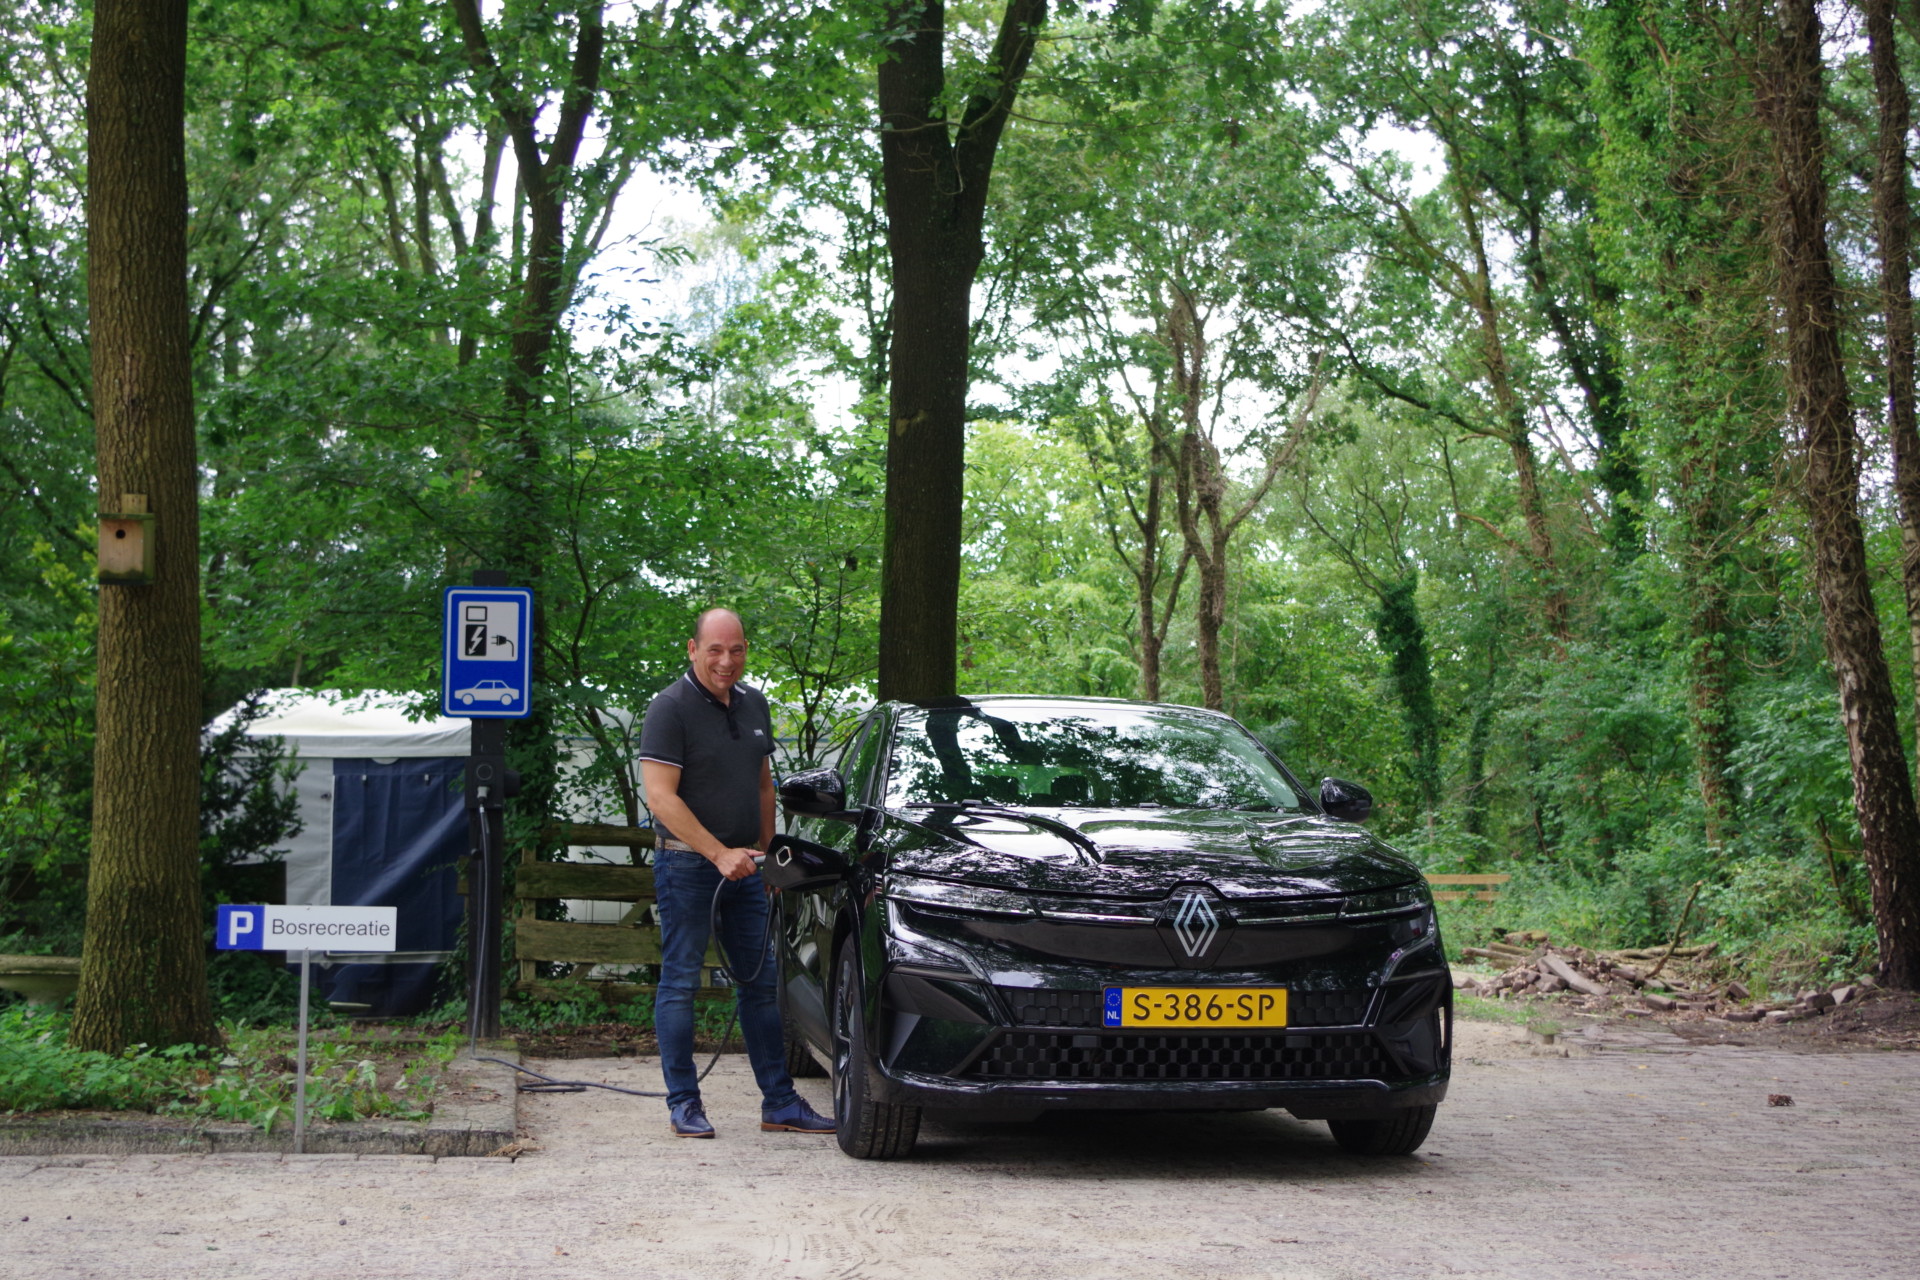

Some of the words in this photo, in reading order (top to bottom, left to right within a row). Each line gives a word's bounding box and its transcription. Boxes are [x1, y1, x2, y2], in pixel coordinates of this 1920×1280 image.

[229, 911, 254, 946] P
[272, 918, 390, 936] Bosrecreatie
[1107, 1011, 1120, 1020] NL
[1133, 993, 1275, 1021] S-386-SP
